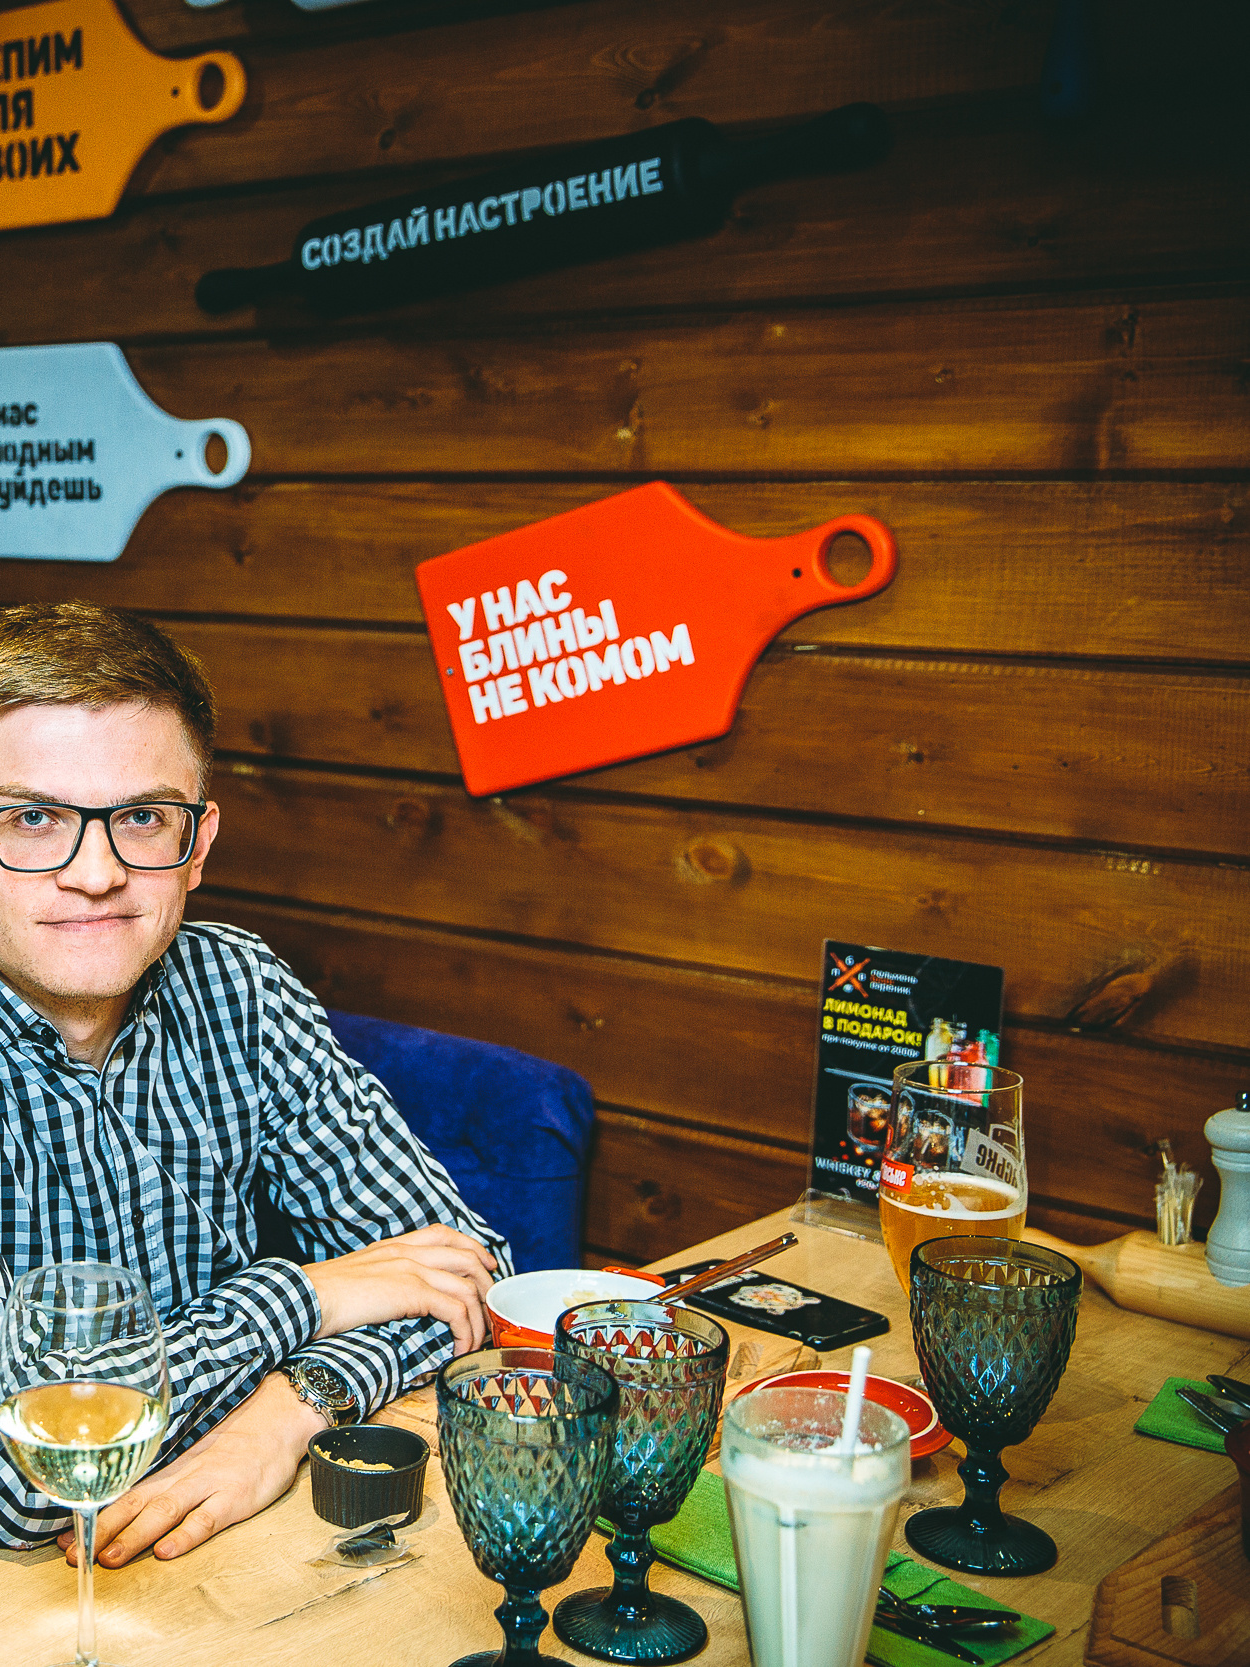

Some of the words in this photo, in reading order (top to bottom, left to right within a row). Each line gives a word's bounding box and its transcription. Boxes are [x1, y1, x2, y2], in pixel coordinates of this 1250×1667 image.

[301, 205, 431, 271] СОЗДАЙ
[433, 157, 664, 242] НАСТРОЕНИЕ
[446, 596, 476, 641] У
[480, 569, 573, 632] НАС
[458, 598, 621, 683] БЛИНЫ
[467, 672, 529, 725] НЕ
[527, 622, 696, 708] КОМОМ
[822, 997, 908, 1028] ЛИМОНАД
[822, 1015, 835, 1031] В
[836, 1018, 923, 1048] ПОДАРОК!
